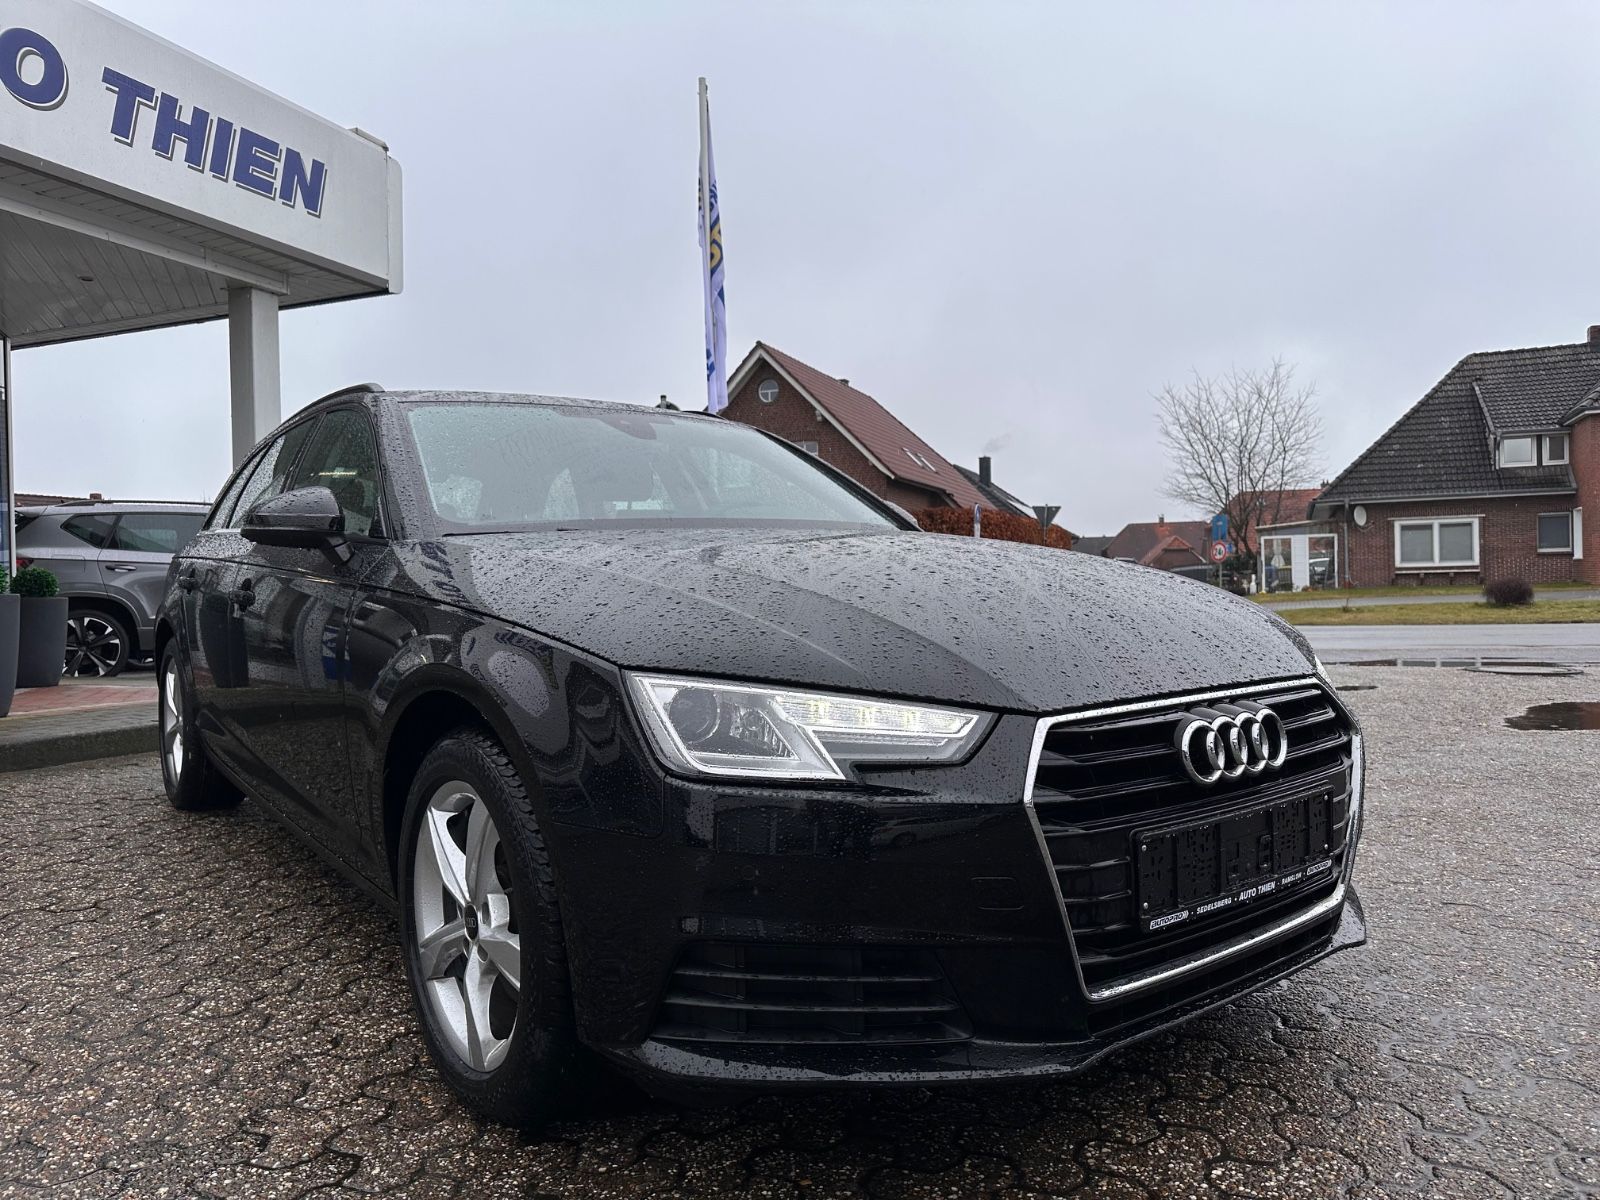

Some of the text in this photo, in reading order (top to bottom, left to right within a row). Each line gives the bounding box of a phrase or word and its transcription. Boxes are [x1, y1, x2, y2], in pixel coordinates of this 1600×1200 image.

[102, 66, 328, 218] THIEN
[1196, 897, 1232, 914] SEDELSBERG
[1238, 887, 1257, 901] AUTO
[1257, 880, 1276, 895] THIEN
